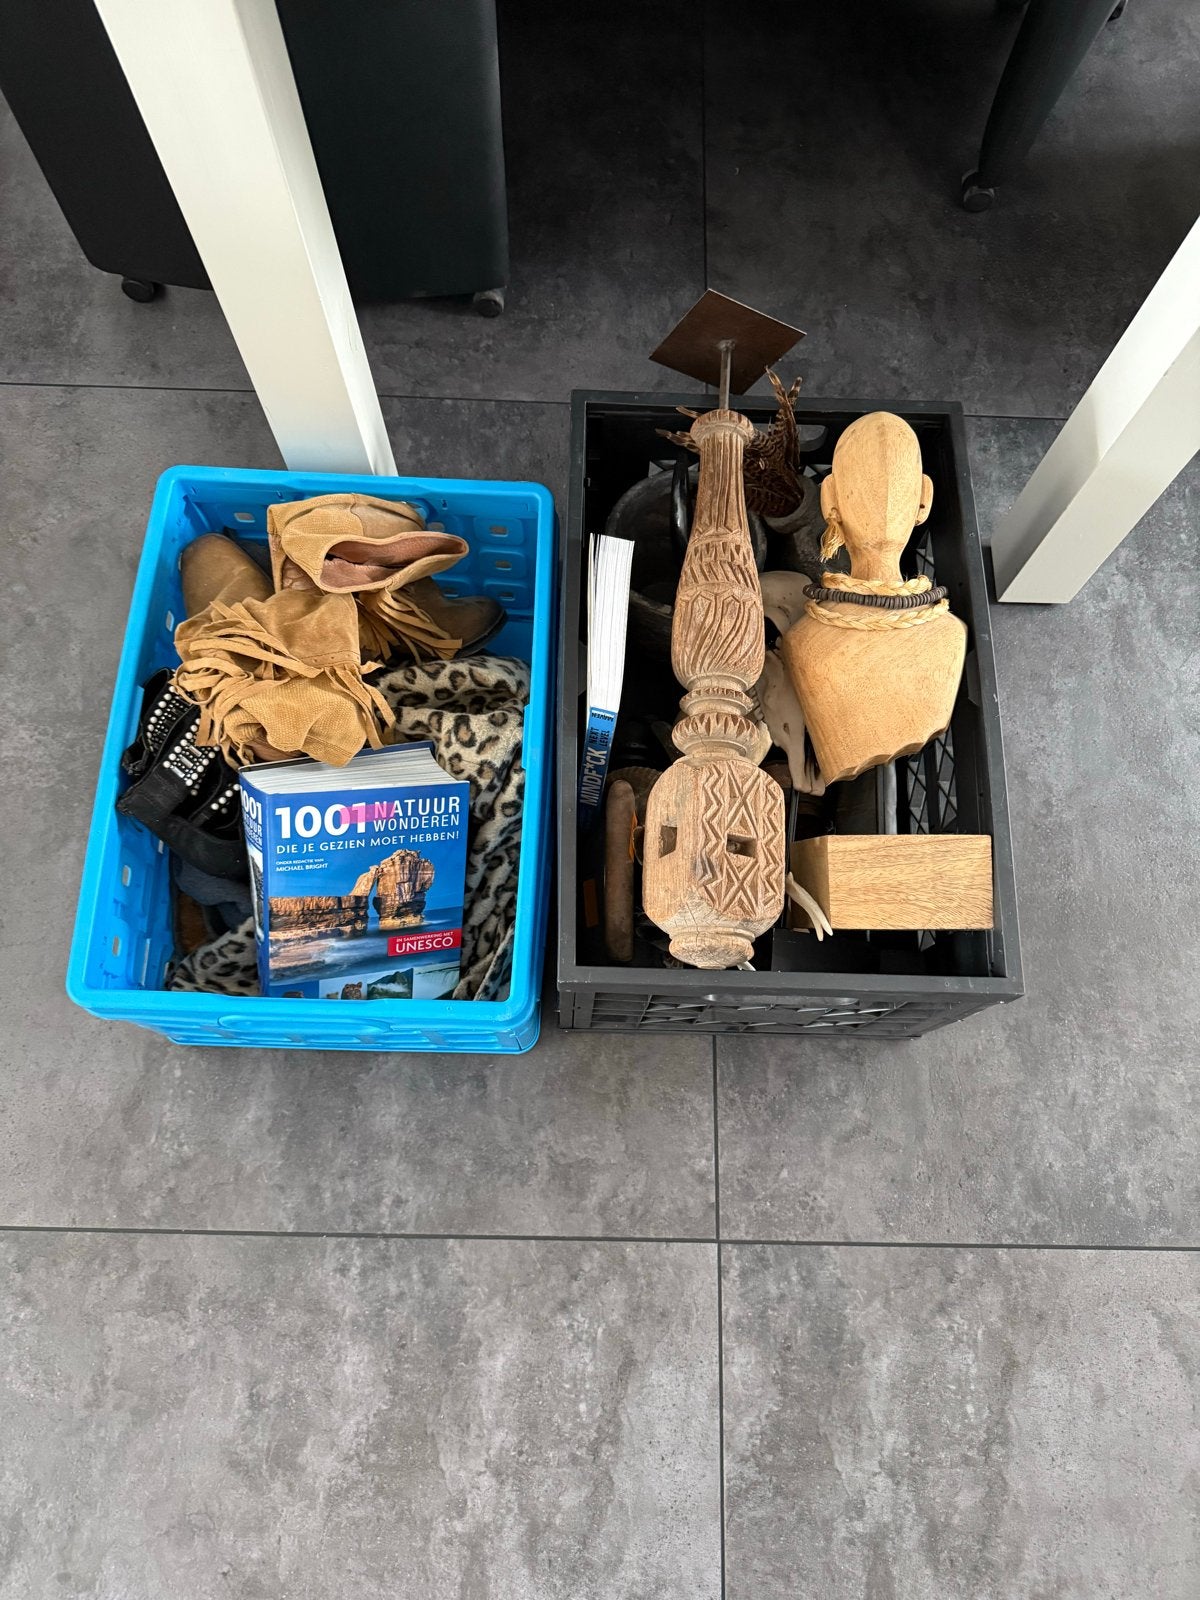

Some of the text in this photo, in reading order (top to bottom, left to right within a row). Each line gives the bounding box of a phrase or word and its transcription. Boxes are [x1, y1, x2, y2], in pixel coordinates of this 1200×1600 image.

[589, 727, 599, 744] NEXT
[600, 730, 610, 747] LEVEL
[275, 796, 460, 839] 1001 NATUUR
[373, 813, 460, 832] WONDEREN
[276, 831, 459, 854] DIE JE GEZIEN MOET HEBBEN!
[305, 862, 329, 870] BRIGHT
[395, 936, 454, 953] UNESCO
[403, 932, 443, 941] SAMENWERKING
